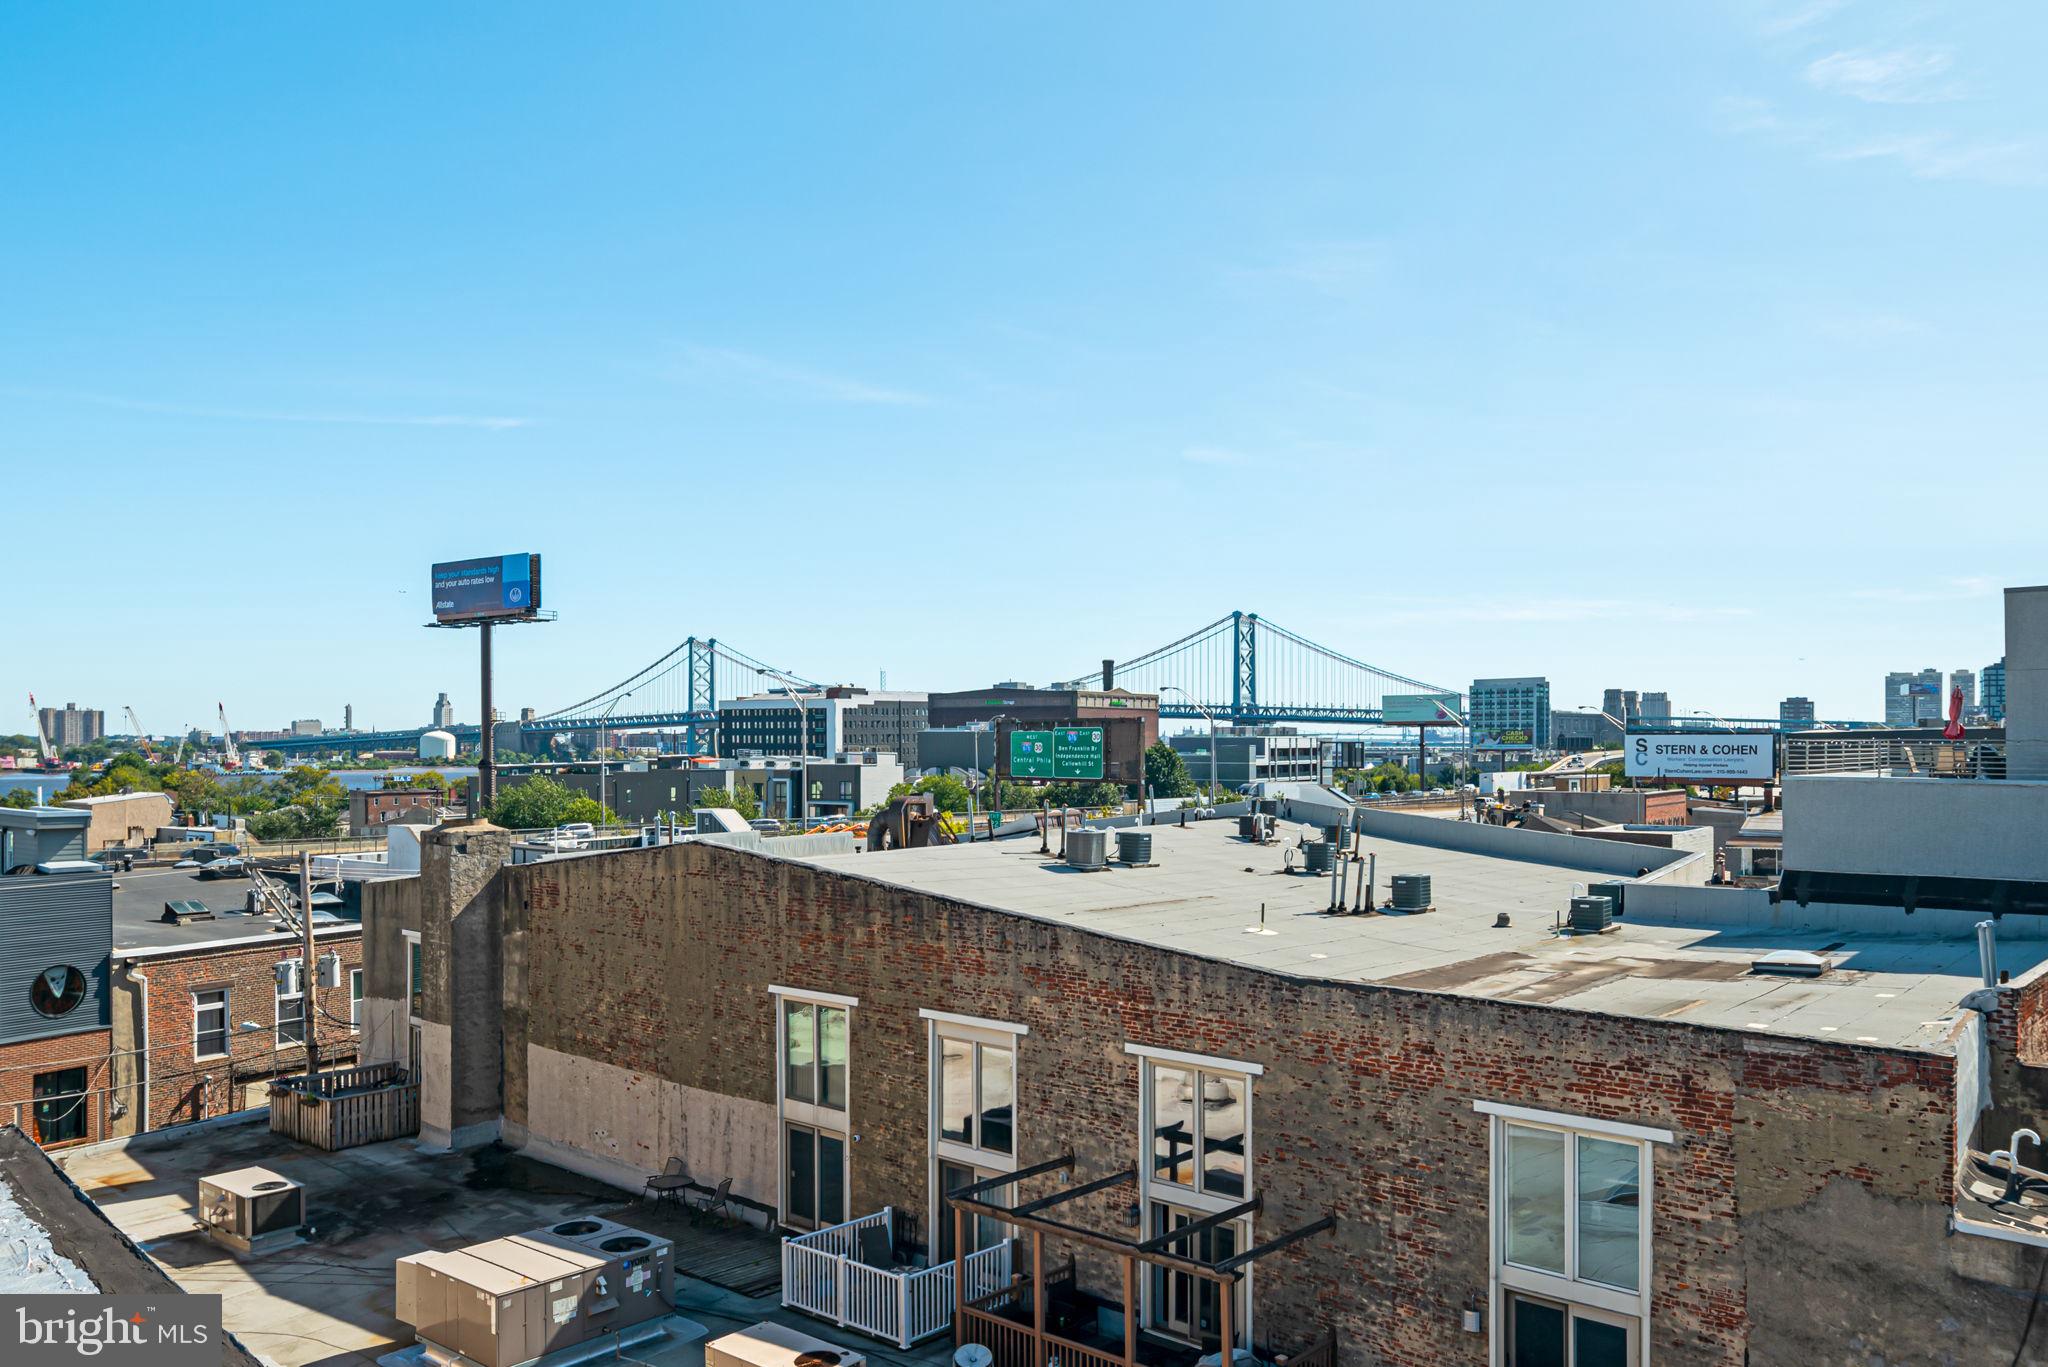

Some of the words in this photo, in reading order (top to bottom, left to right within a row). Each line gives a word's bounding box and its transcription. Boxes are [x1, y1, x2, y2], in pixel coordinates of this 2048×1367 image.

[487, 566, 499, 575] high
[435, 581, 445, 589] and
[445, 580, 457, 589] your
[457, 578, 470, 586] auto
[471, 577, 484, 585] rates
[435, 600, 454, 609] Allstate
[1635, 737, 1648, 753] S
[1655, 744, 1696, 755] STERN
[1700, 744, 1709, 755] &
[1712, 744, 1758, 755] COHEN
[1635, 752, 1648, 766] C
[631, 1255, 650, 1266] YORK
